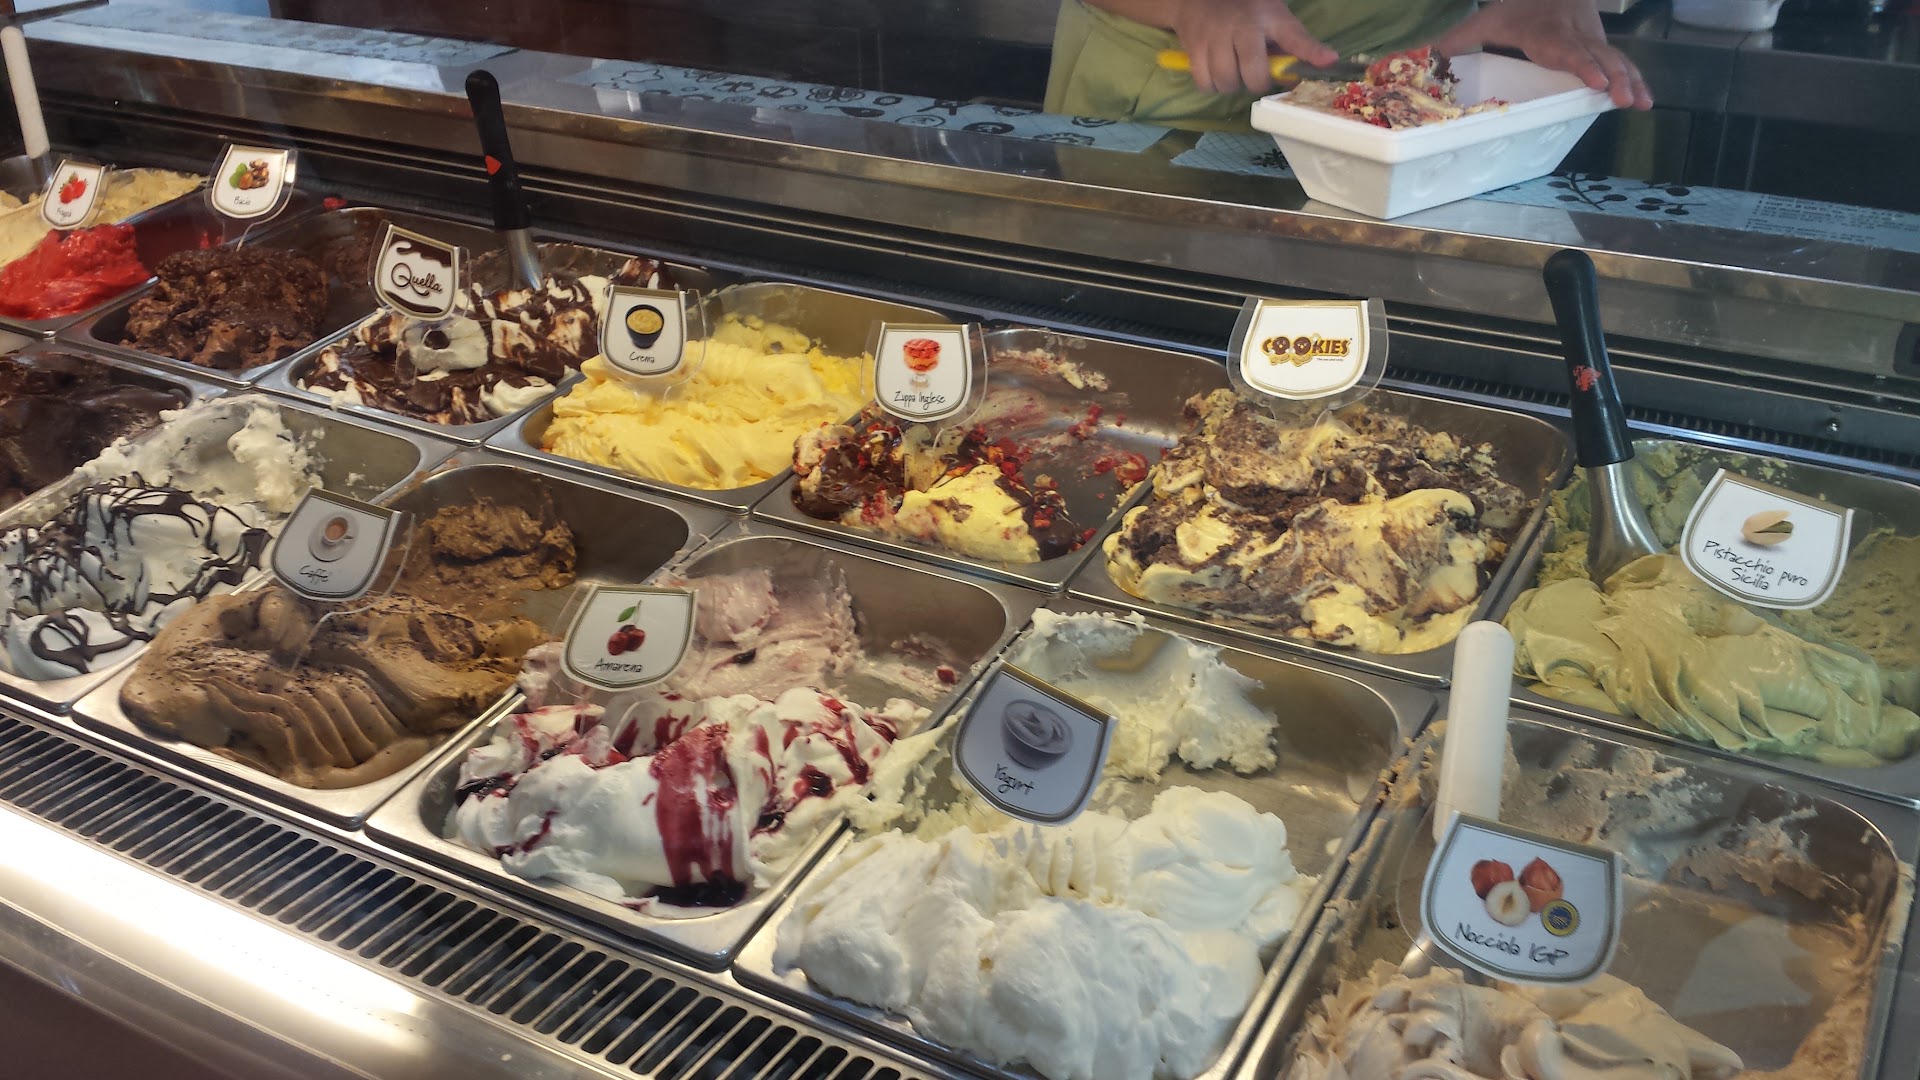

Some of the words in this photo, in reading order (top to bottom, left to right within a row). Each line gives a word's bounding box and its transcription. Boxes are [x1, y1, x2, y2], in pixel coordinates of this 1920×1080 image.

[391, 262, 442, 296] Quella
[629, 351, 655, 363] Crema
[1262, 336, 1350, 356] COOKIES
[894, 390, 916, 408] Zuppa
[919, 391, 946, 411] Inglese
[1702, 540, 1775, 575] Pistacchio
[1777, 571, 1808, 586] puro
[1731, 567, 1770, 590] Sicilia
[594, 657, 643, 673] Amarena
[994, 763, 1035, 796] Yogurt
[1455, 921, 1521, 956] Nocciola
[1528, 942, 1570, 966] IGP
